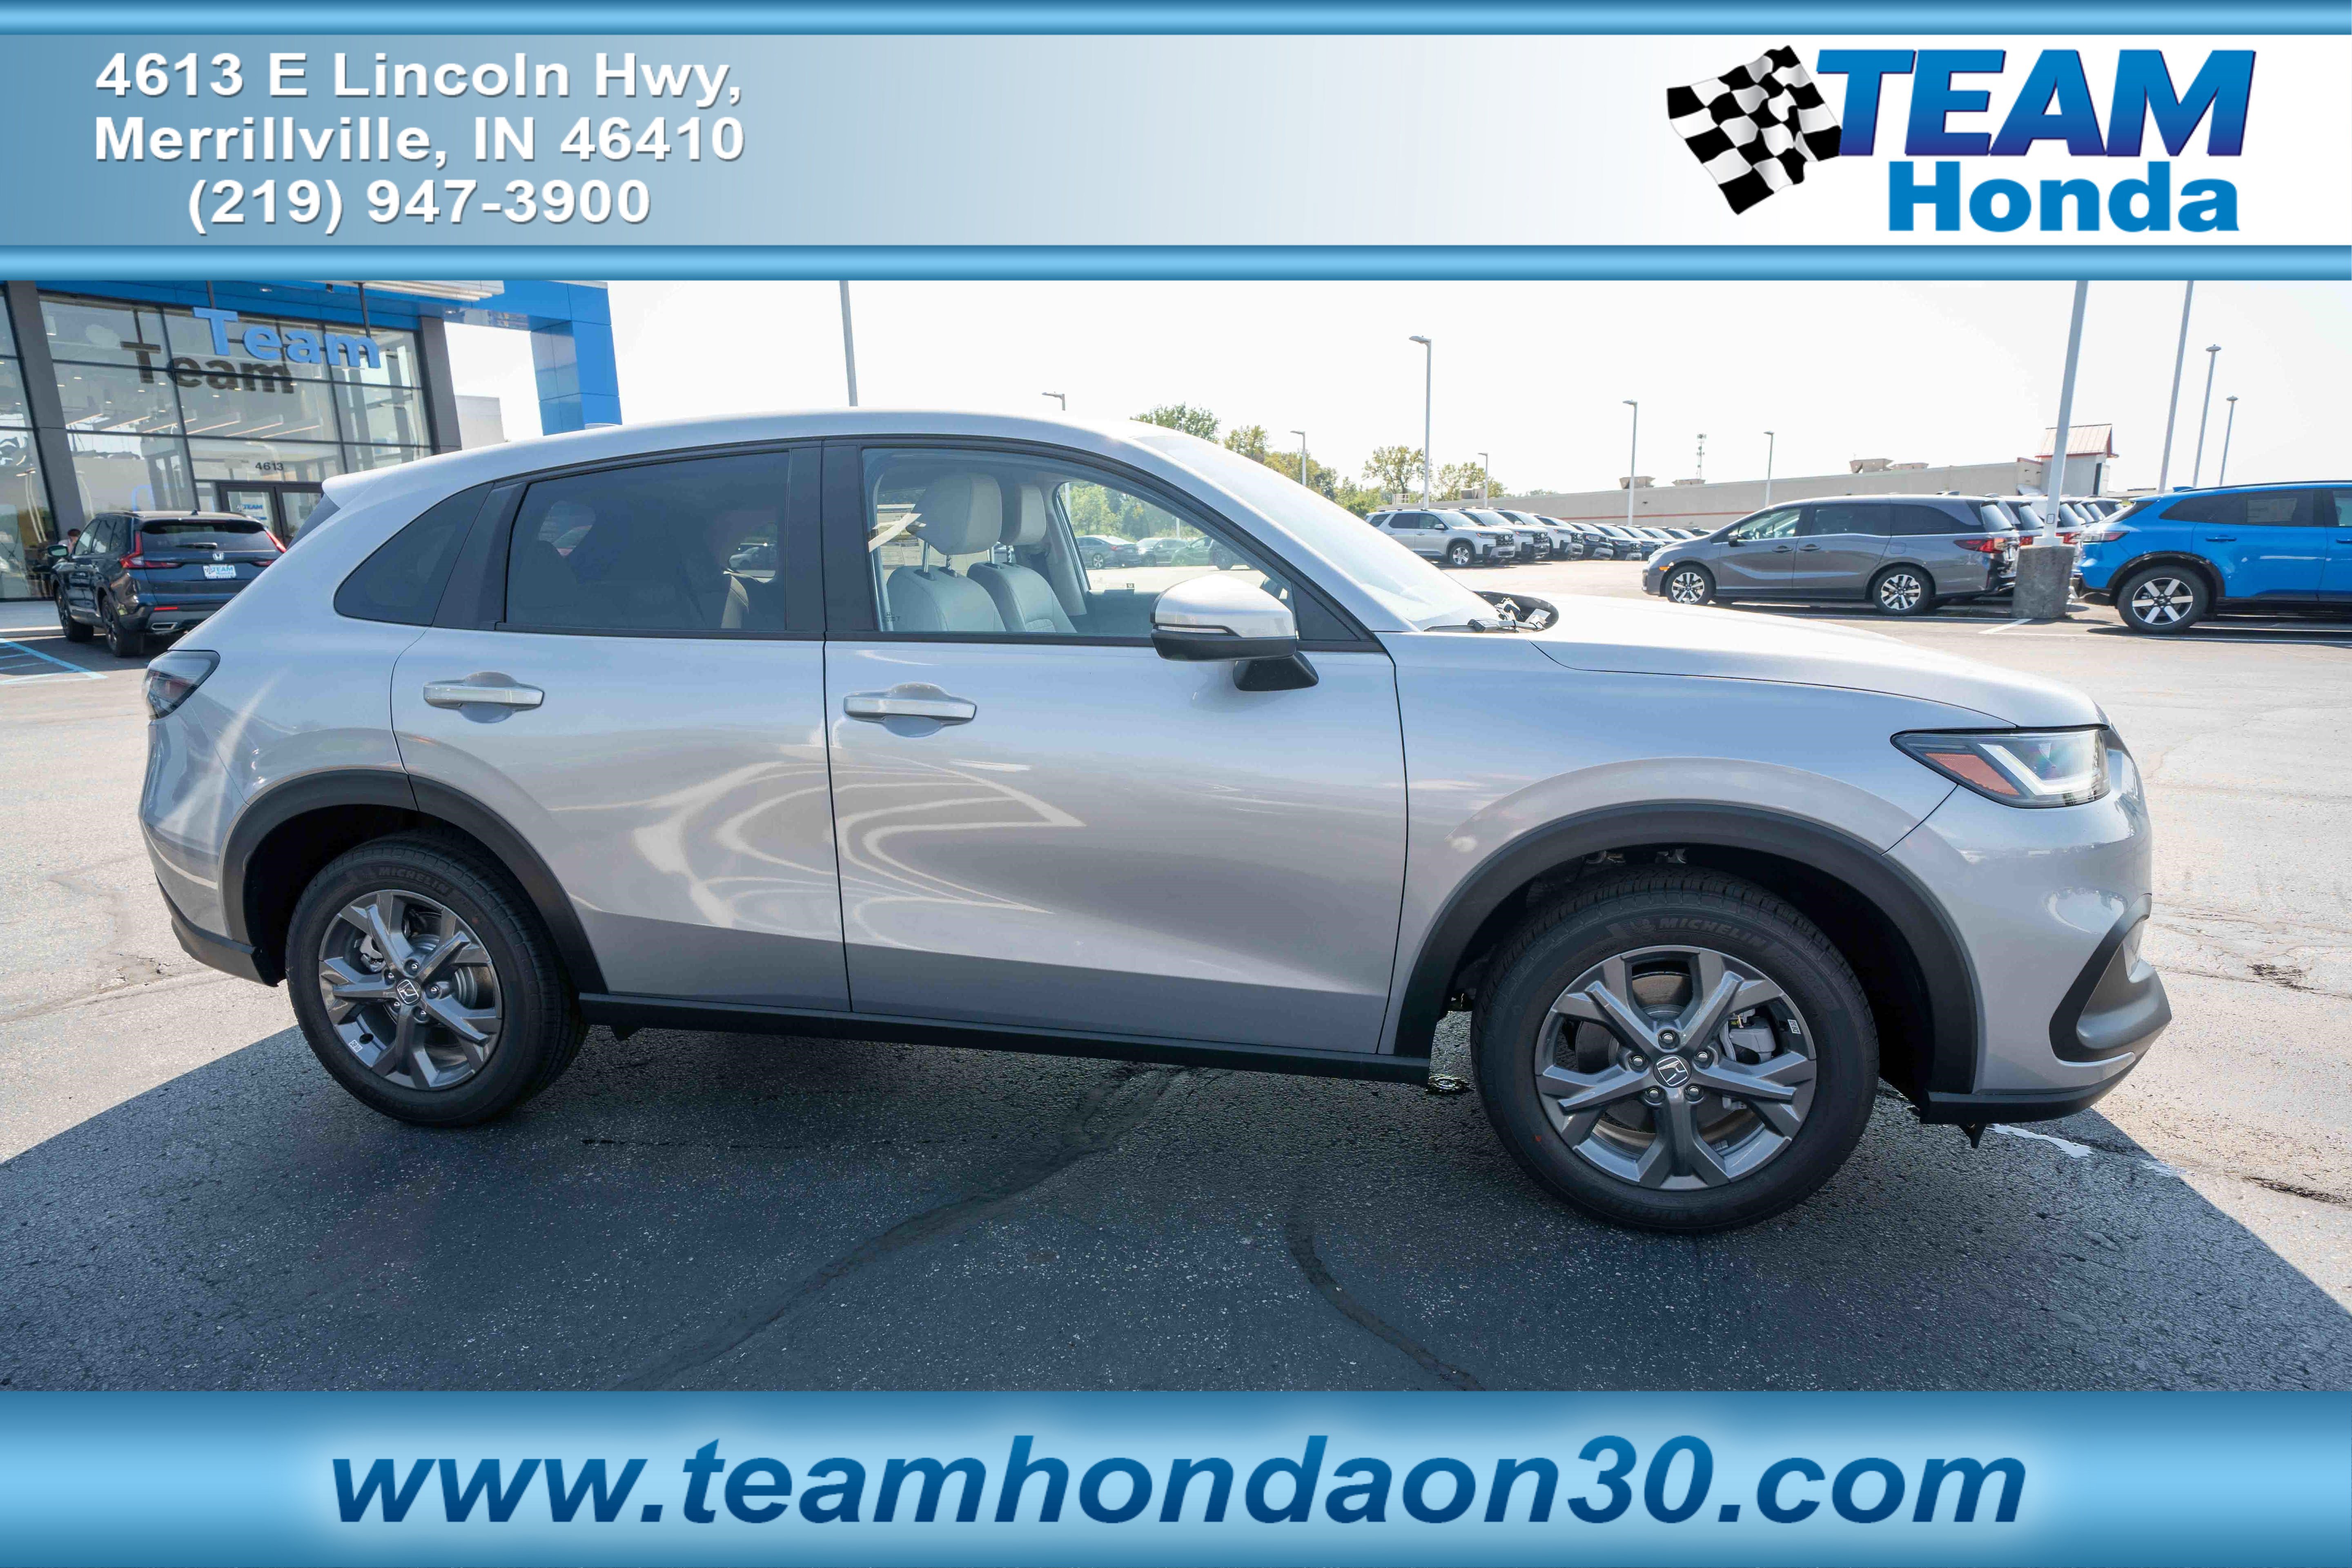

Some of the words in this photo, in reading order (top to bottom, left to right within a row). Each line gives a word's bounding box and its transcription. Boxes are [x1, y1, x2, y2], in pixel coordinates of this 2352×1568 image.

[192, 307, 381, 368] Team
[255, 462, 284, 471] 4613
[1659, 918, 1768, 947] MICHELIN
